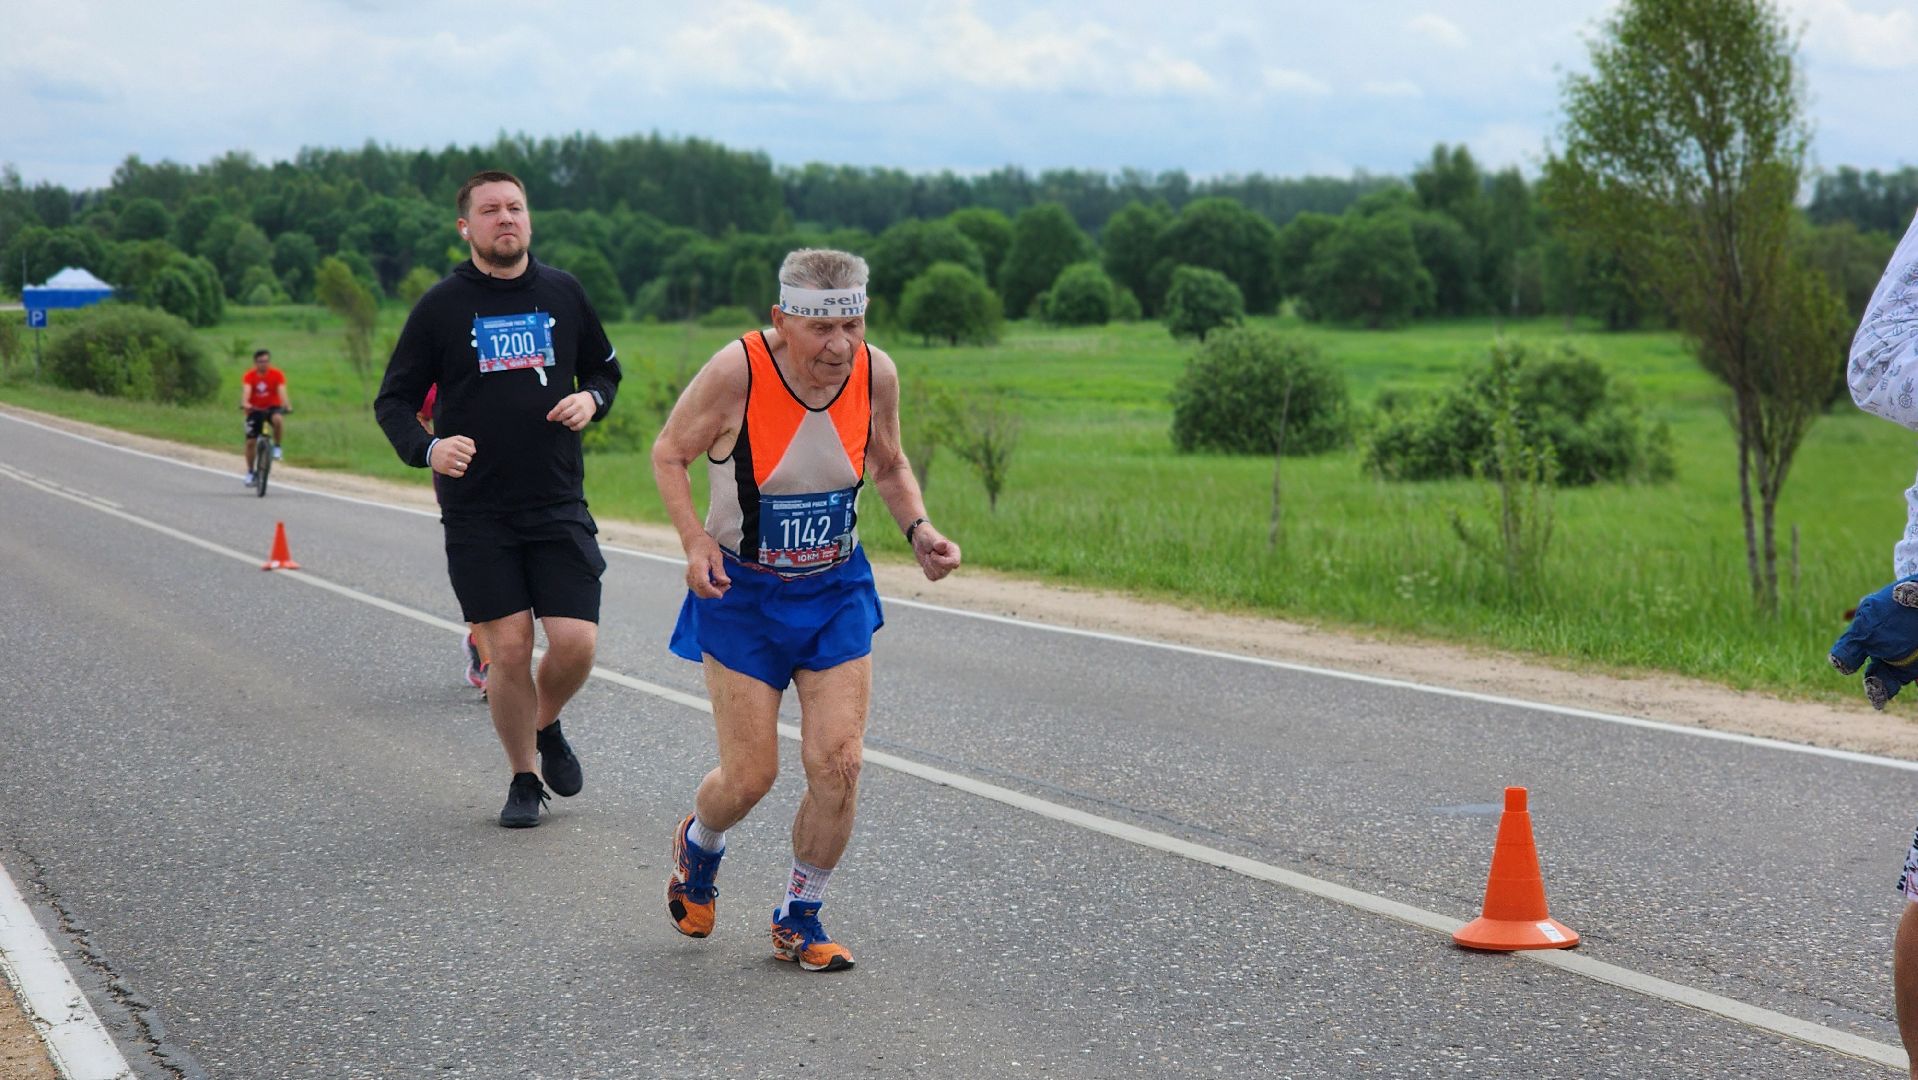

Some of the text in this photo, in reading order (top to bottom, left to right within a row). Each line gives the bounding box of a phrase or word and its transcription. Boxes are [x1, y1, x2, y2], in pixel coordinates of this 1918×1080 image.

[31, 311, 44, 326] P
[791, 305, 829, 316] san
[490, 331, 536, 357] 1200
[780, 516, 831, 549] 1142
